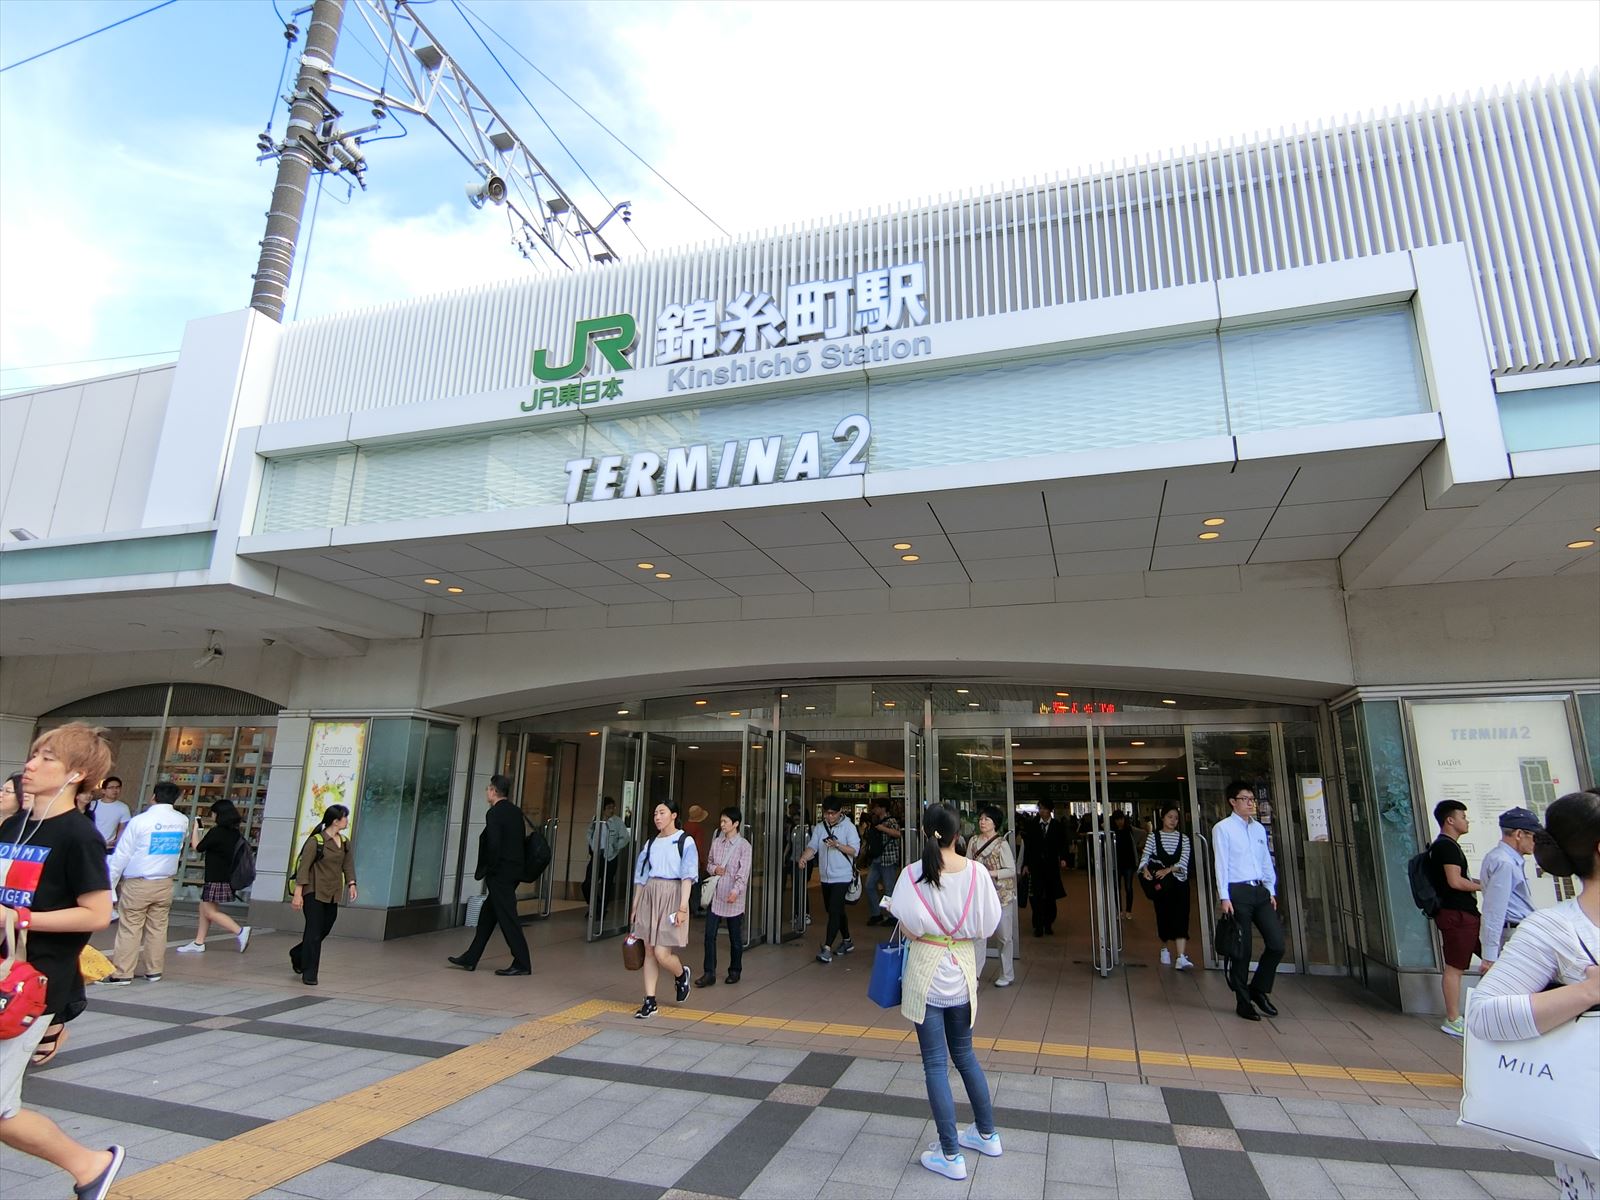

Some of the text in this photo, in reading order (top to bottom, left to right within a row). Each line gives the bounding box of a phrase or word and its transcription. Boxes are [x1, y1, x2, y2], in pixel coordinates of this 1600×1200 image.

[655, 261, 929, 366] 錦糸町駅
[532, 313, 639, 381] JR
[667, 334, 932, 392] Kinshichō Station
[319, 756, 352, 766] Summer
[0, 844, 50, 861] OMMY
